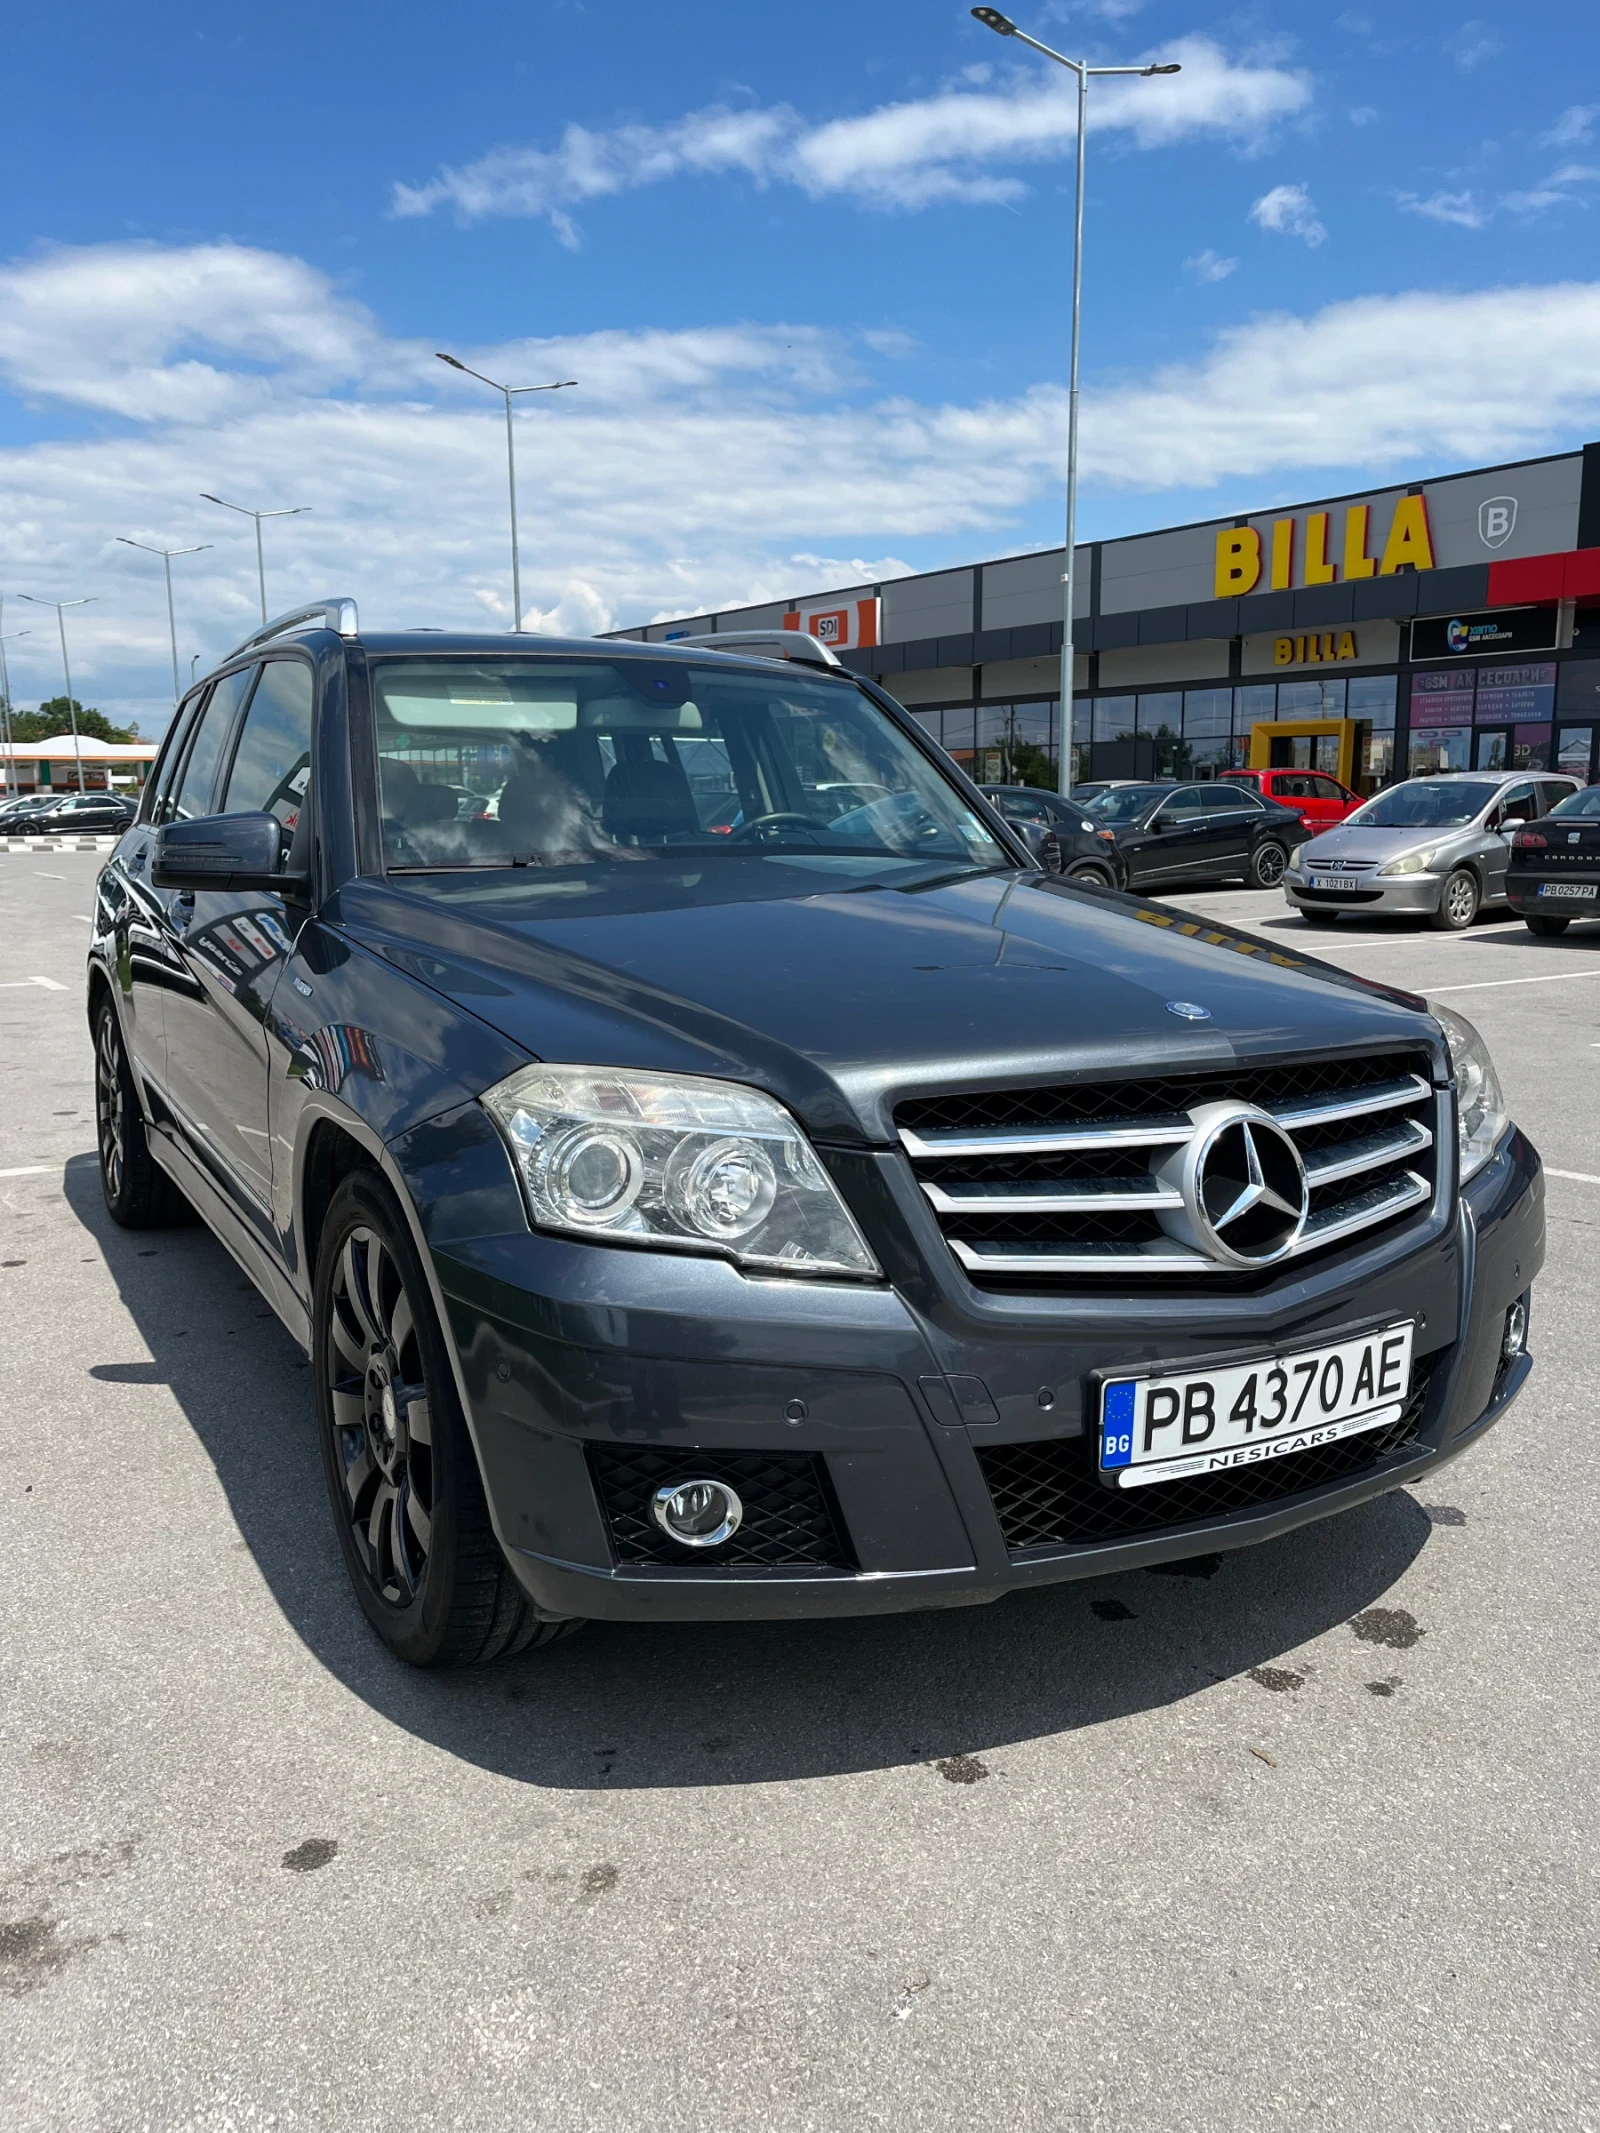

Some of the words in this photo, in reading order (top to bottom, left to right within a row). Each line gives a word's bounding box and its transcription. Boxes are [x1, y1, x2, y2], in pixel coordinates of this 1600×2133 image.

[1214, 494, 1436, 598] BILLA
[820, 619, 837, 636] SDI
[1273, 631, 1357, 666] BILLA
[1425, 675, 1448, 690] GSM
[1456, 668, 1539, 688] АКСЕСОАРИ
[1513, 744, 1531, 757] 3D
[1142, 1381, 1216, 1452] PB
[1229, 1355, 1344, 1433] 4370
[1350, 1335, 1405, 1407] AE
[1105, 1434, 1130, 1455] BG
[1208, 1427, 1338, 1469] NESICARS
